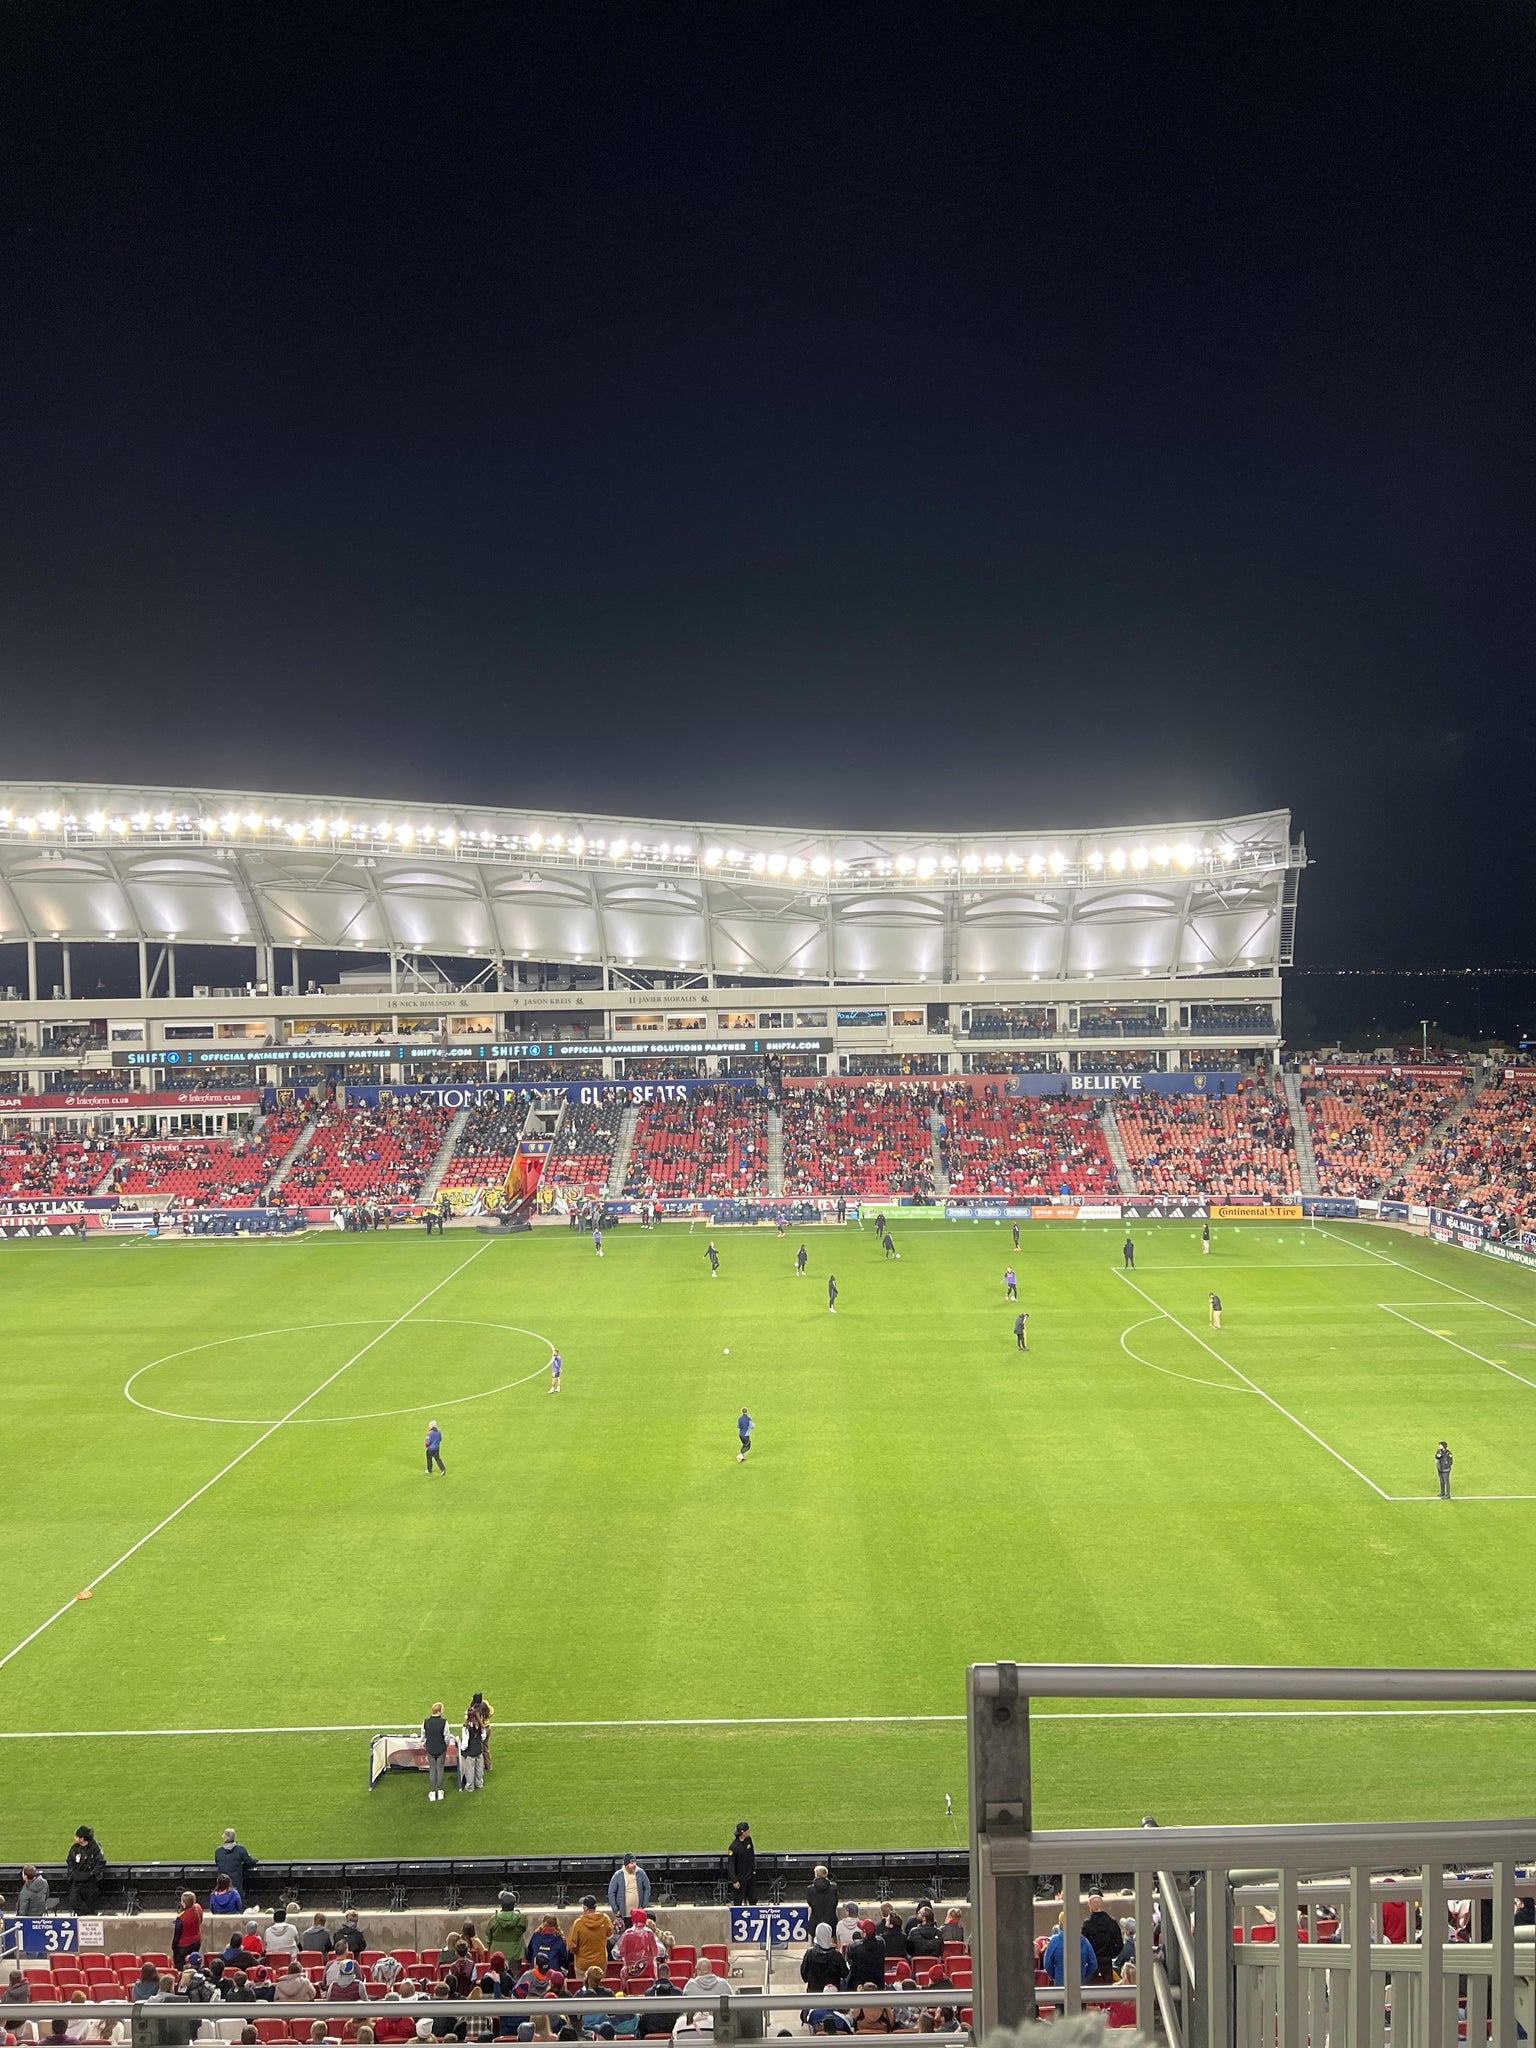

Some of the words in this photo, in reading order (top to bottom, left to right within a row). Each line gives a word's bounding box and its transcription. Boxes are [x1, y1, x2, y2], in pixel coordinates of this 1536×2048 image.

[388, 1000, 398, 1008] 18
[513, 998, 519, 1006] 9
[524, 998, 548, 1006] JASON
[550, 997, 572, 1005] KREIS
[638, 996, 662, 1004] JAVIER
[200, 1052, 246, 1061] OFFICIAL
[247, 1051, 291, 1061] PAYMENT
[348, 1050, 391, 1058] PARTNER
[560, 1045, 604, 1054] OFFICIAL
[605, 1044, 649, 1053] PAYMENT
[650, 1043, 703, 1053] SOLUTIONS
[704, 1042, 747, 1052] PARTNER
[766, 1041, 820, 1051] SHIFT4.COM
[1071, 1075, 1142, 1090] BELIEVE
[76, 1096, 110, 1106] Interform
[189, 1093, 222, 1103] Interform
[632, 1085, 687, 1104] SEATS
[1218, 1206, 1268, 1218] Continental
[1276, 1206, 1297, 1217] Tire
[1484, 1242, 1506, 1258] ALSCO
[733, 1919, 764, 1942] 37
[776, 1919, 807, 1941] 36
[44, 1929, 75, 1952] 37
